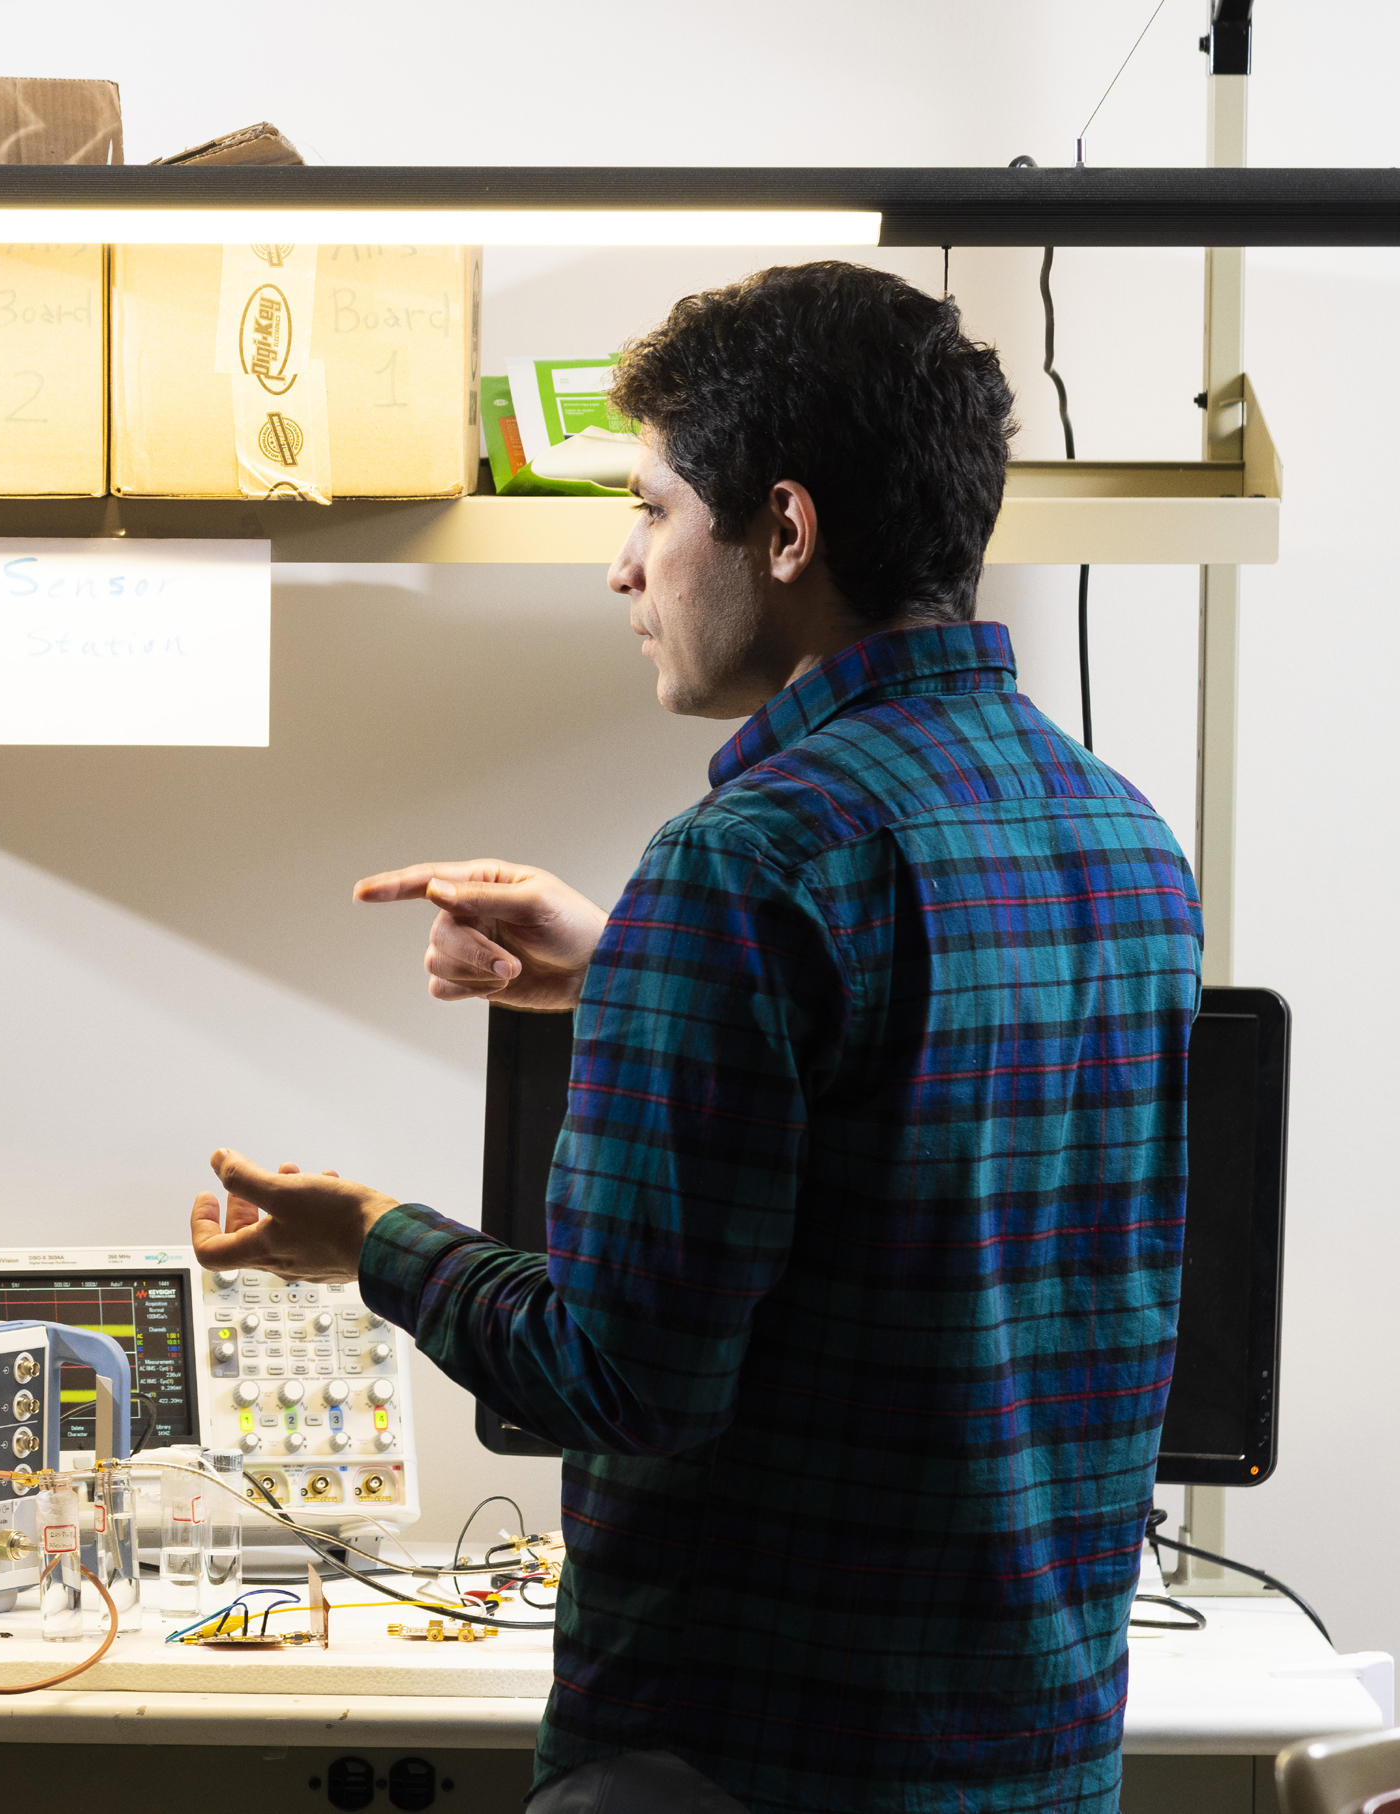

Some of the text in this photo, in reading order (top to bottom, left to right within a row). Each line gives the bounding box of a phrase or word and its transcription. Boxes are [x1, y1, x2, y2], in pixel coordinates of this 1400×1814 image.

[273, 313, 281, 348] ELECTRONICS
[332, 286, 450, 338] Board
[4, 369, 48, 423] 2
[374, 349, 408, 408] 1
[3, 557, 180, 597] Sensor
